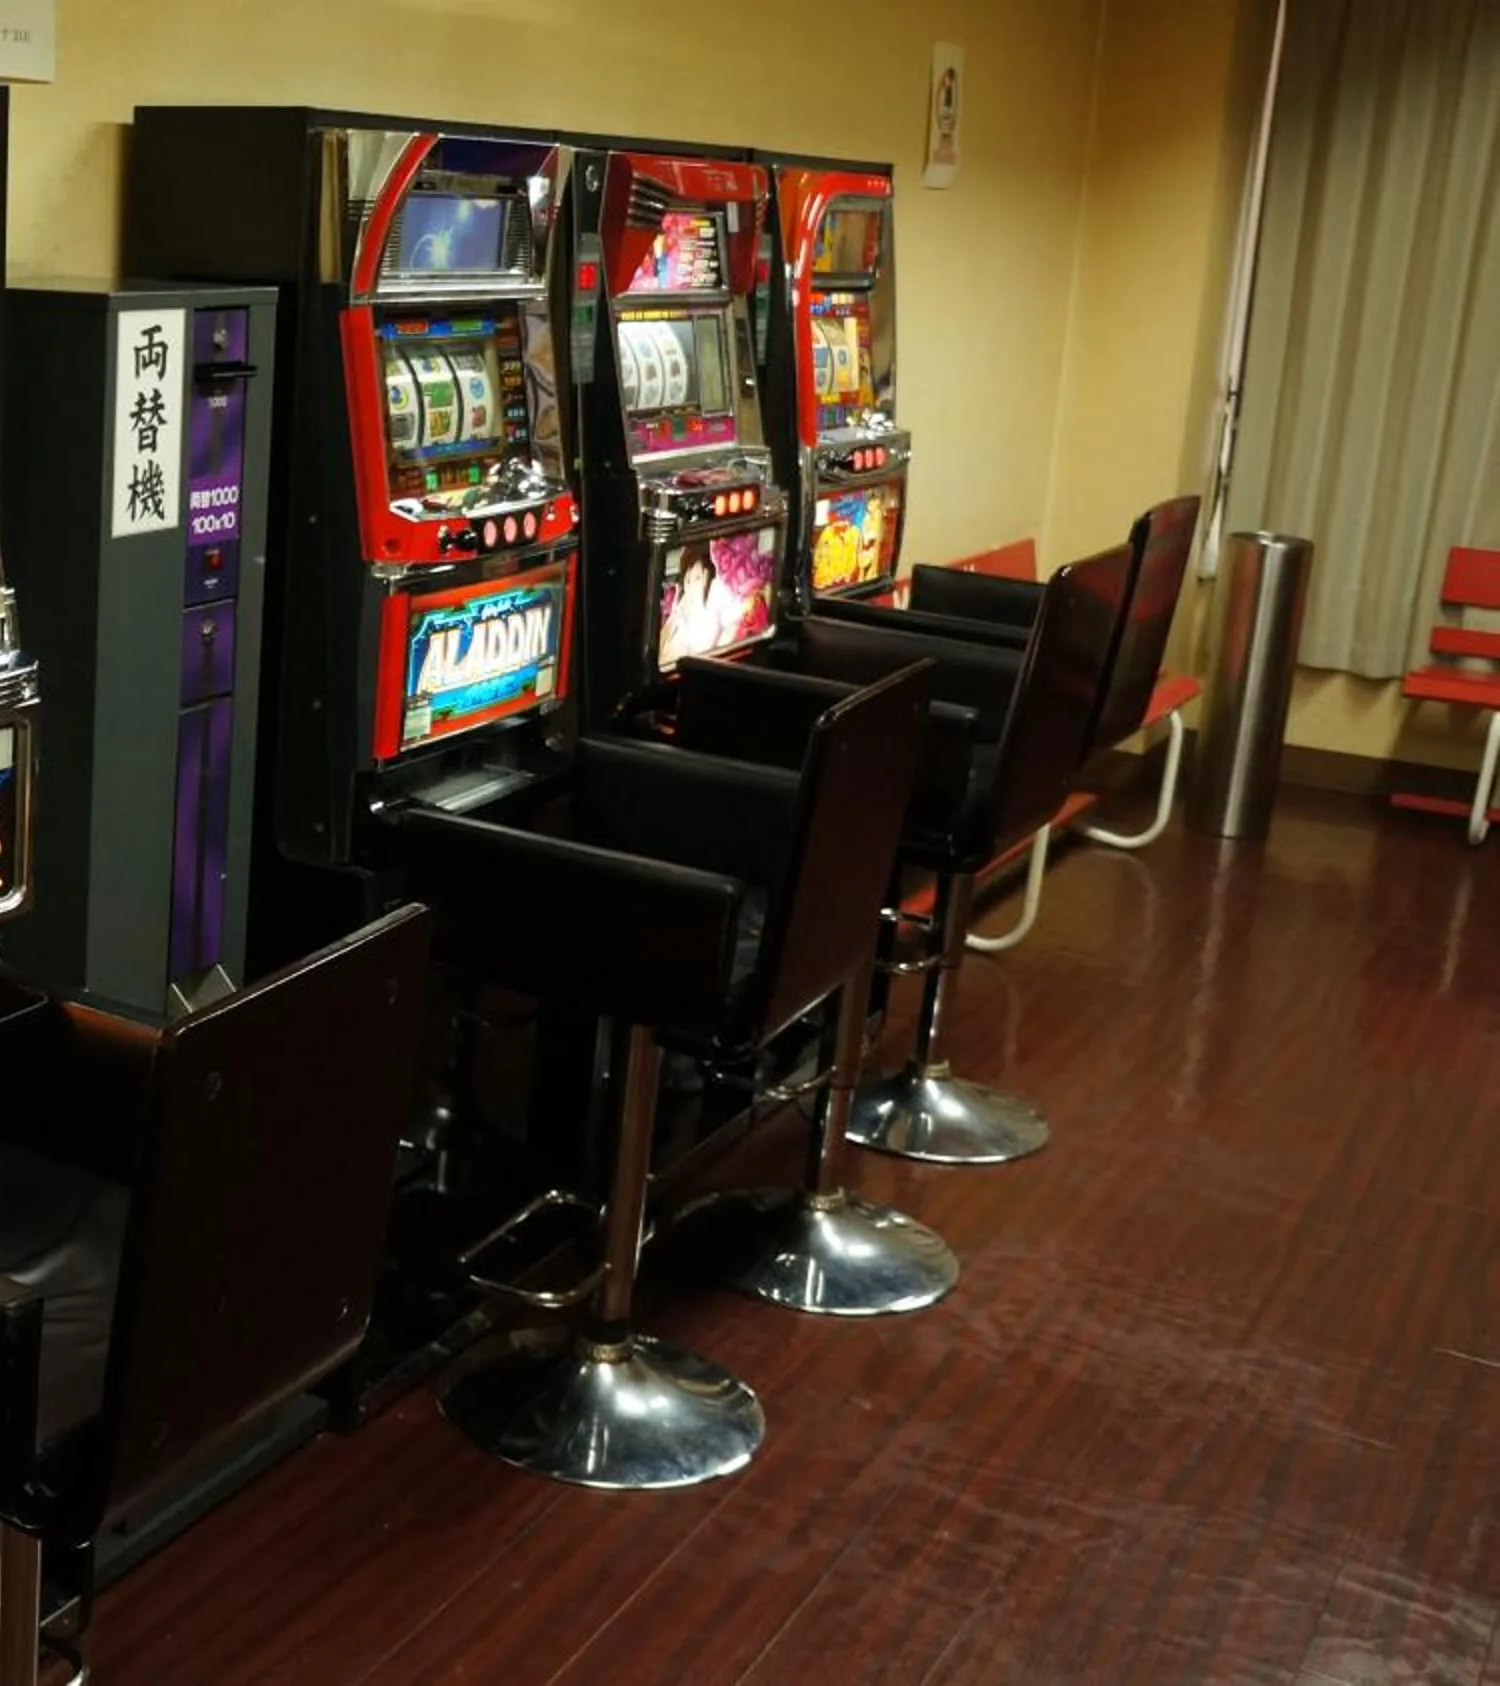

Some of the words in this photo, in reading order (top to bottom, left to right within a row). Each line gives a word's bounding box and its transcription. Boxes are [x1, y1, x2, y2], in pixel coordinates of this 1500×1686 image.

[126, 324, 169, 522] 両替機
[416, 606, 552, 694] ALADDIN
